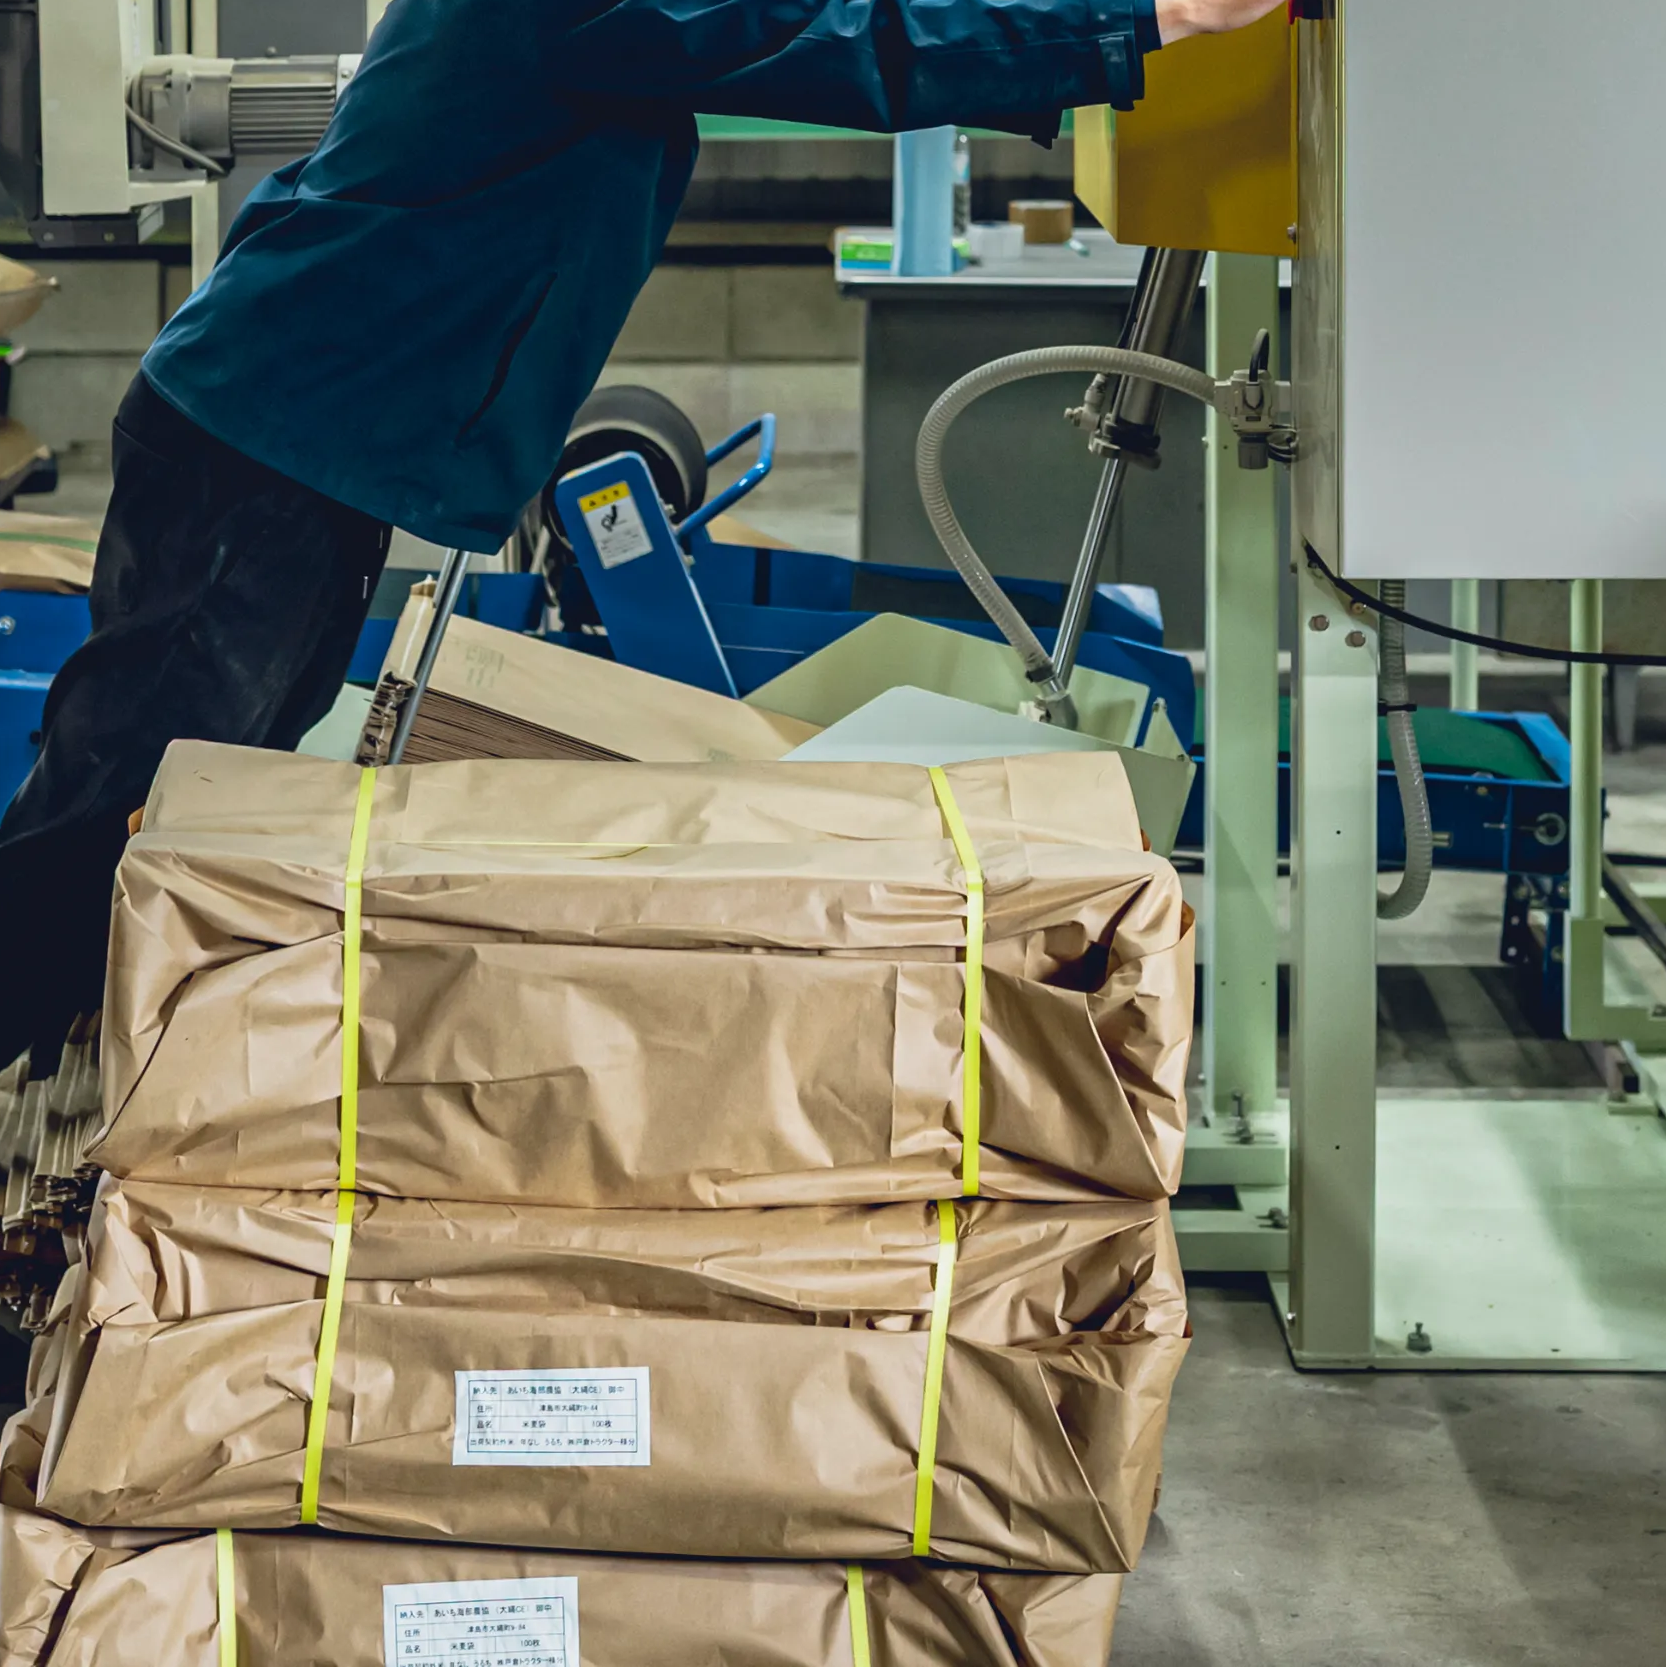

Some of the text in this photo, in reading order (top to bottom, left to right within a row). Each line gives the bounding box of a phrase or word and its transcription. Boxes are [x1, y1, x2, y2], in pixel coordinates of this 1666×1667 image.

[476, 1404, 493, 1413] 住所
[476, 1420, 493, 1429] 品名
[591, 1419, 613, 1429] 100枚
[404, 1629, 421, 1638] 住所
[404, 1644, 421, 1654] 品名
[520, 1638, 541, 1648] 100枚
